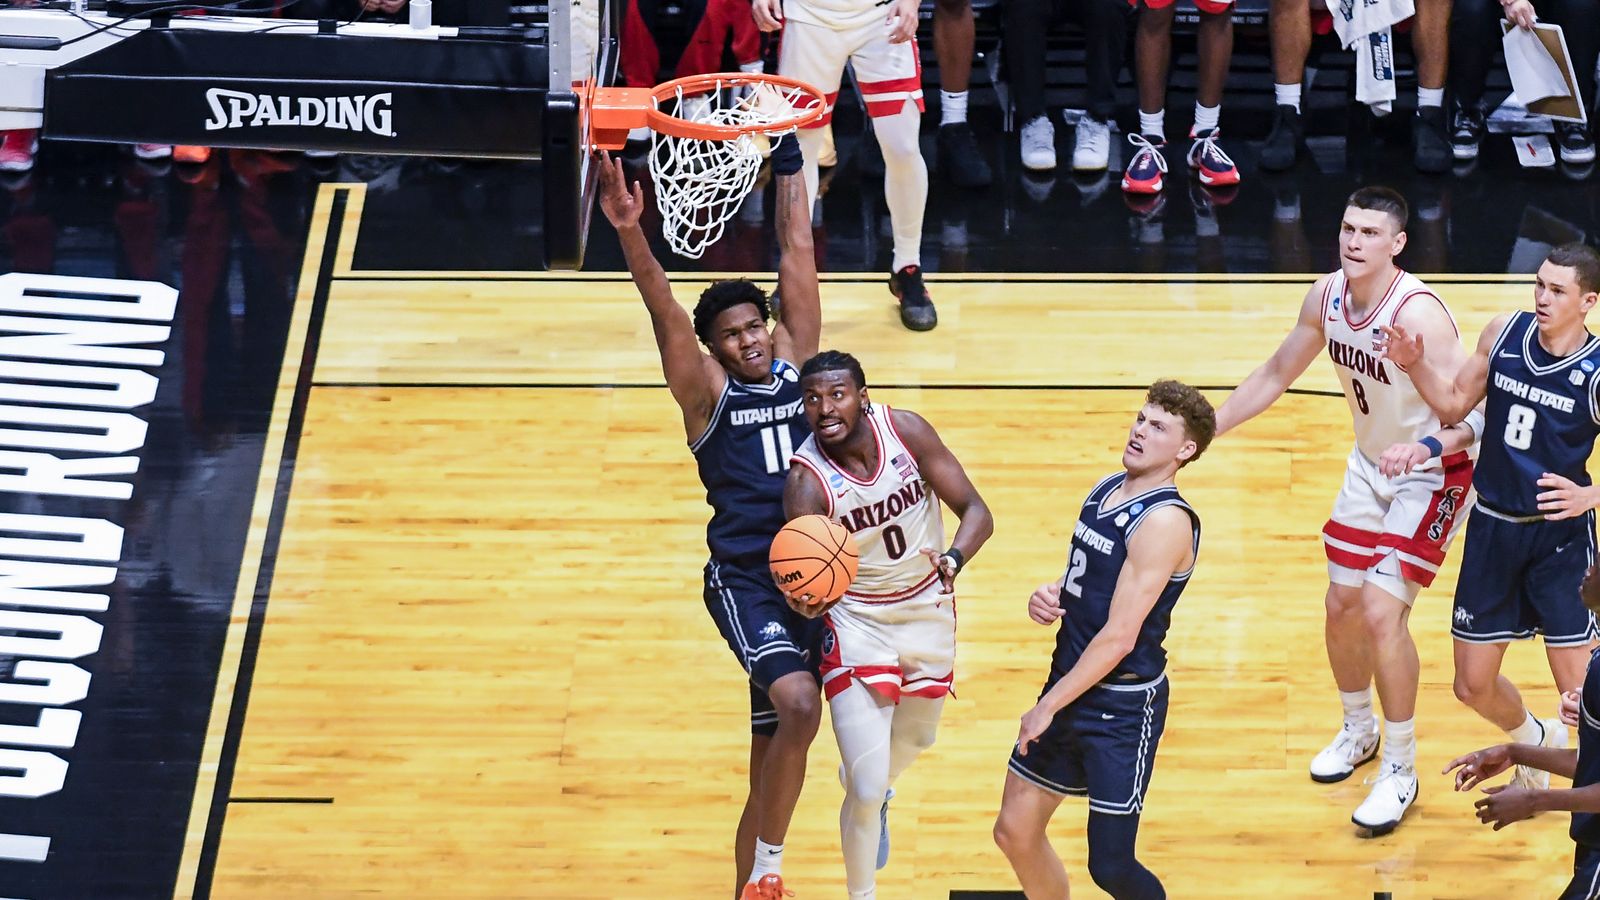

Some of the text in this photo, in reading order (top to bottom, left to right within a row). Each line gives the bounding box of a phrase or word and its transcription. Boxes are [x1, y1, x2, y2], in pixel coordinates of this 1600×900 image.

[205, 87, 393, 137] SPALDING
[0, 272, 180, 500] ROUND
[1352, 378, 1370, 416] 8
[1494, 371, 1576, 414] UTAH STATE
[730, 406, 774, 427] UTAH
[1503, 403, 1537, 451] 8
[760, 423, 794, 475] 11
[1427, 485, 1464, 542] CATS
[882, 524, 907, 560] 0
[1082, 527, 1115, 556] STATE
